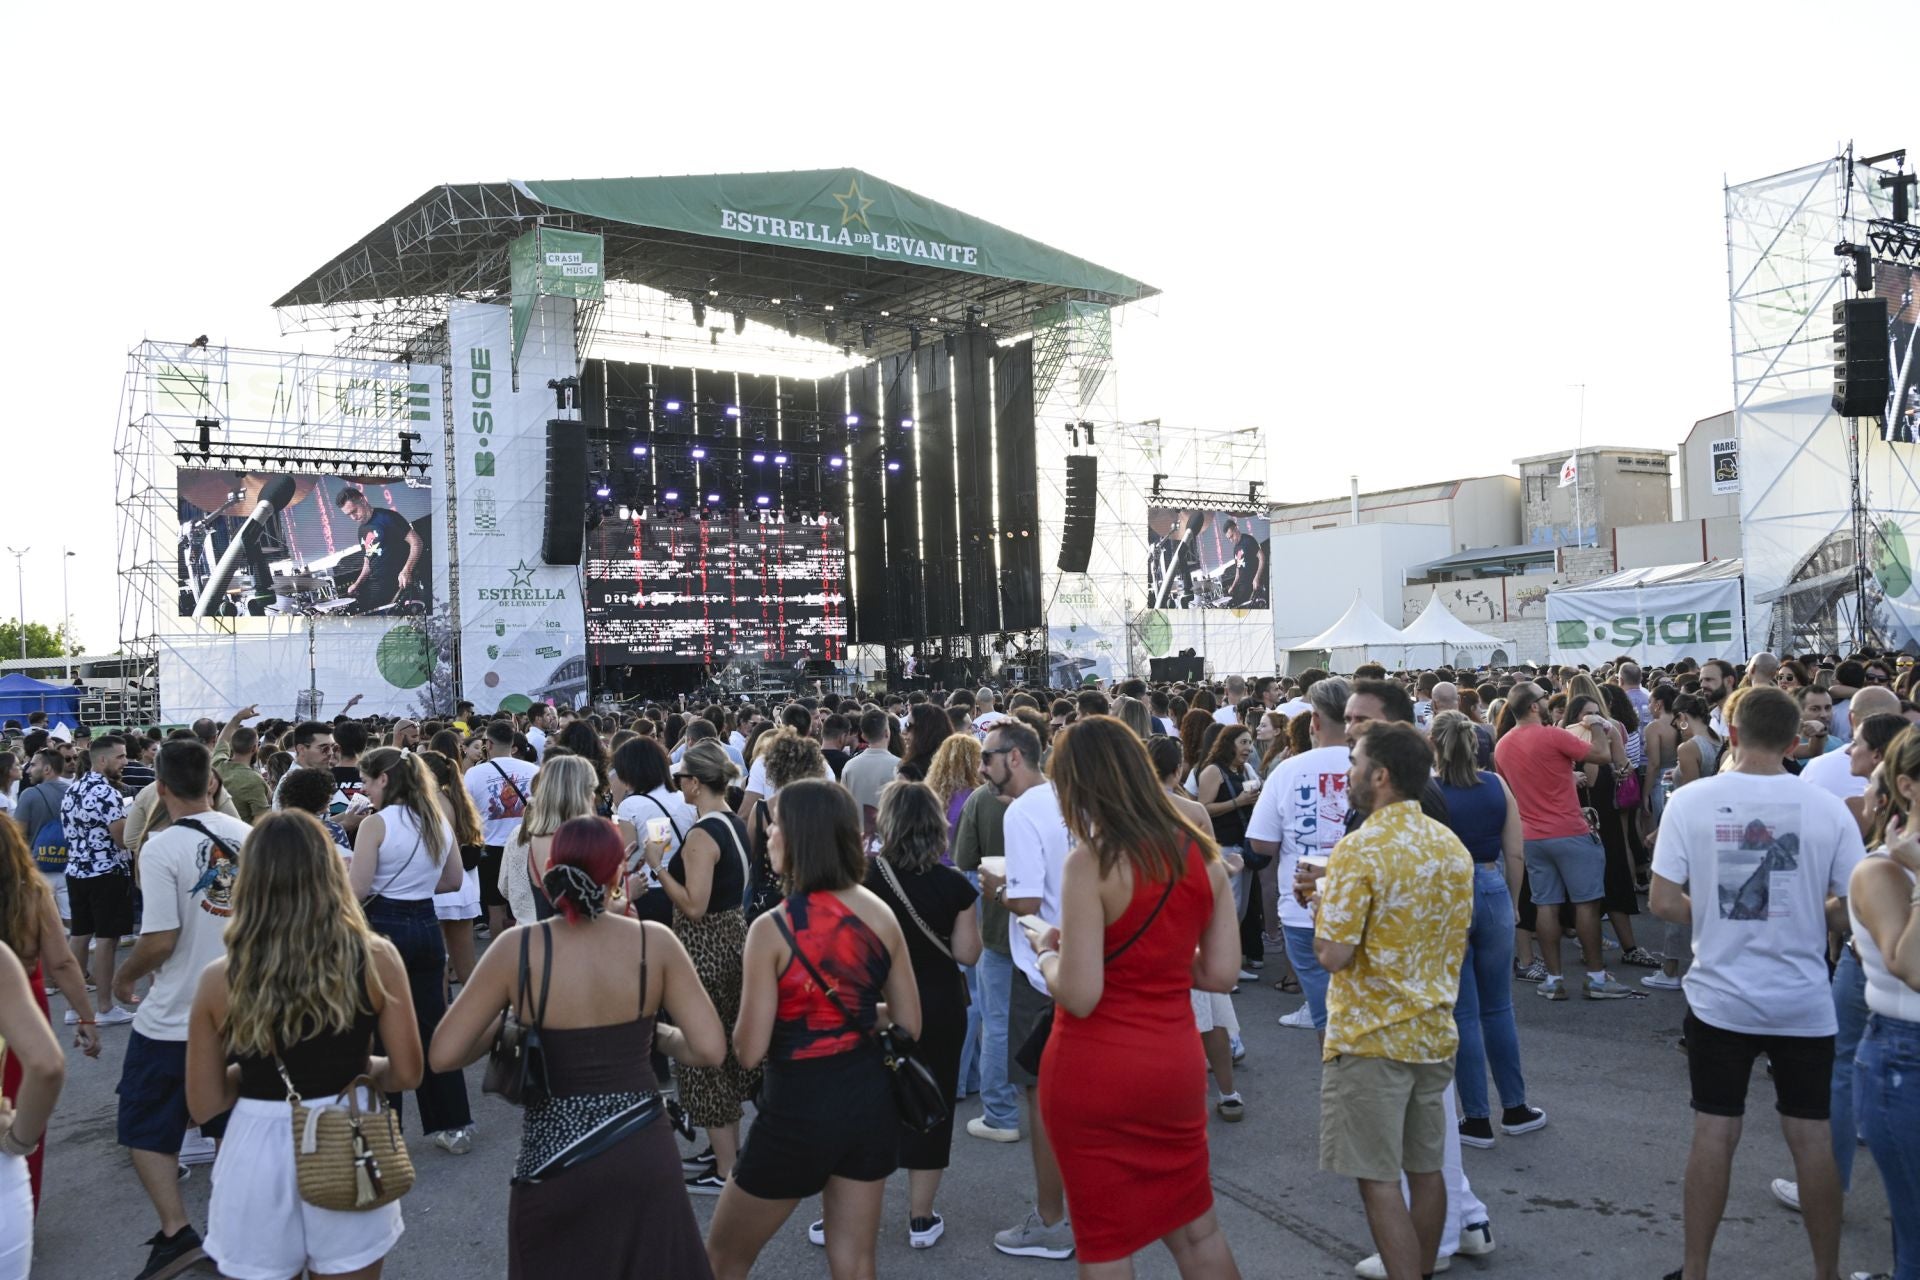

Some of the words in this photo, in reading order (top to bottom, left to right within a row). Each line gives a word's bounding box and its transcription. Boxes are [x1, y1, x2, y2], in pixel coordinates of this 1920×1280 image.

[720, 209, 853, 246] ESTRELLA
[854, 233, 871, 244] DE
[871, 232, 978, 265] LEVANTE
[548, 254, 580, 263] CRASH
[566, 266, 594, 275] MUSIC
[477, 588, 566, 600] ESTRELLA
[1059, 593, 1094, 603] ESTRE
[38, 846, 66, 856] UCA
